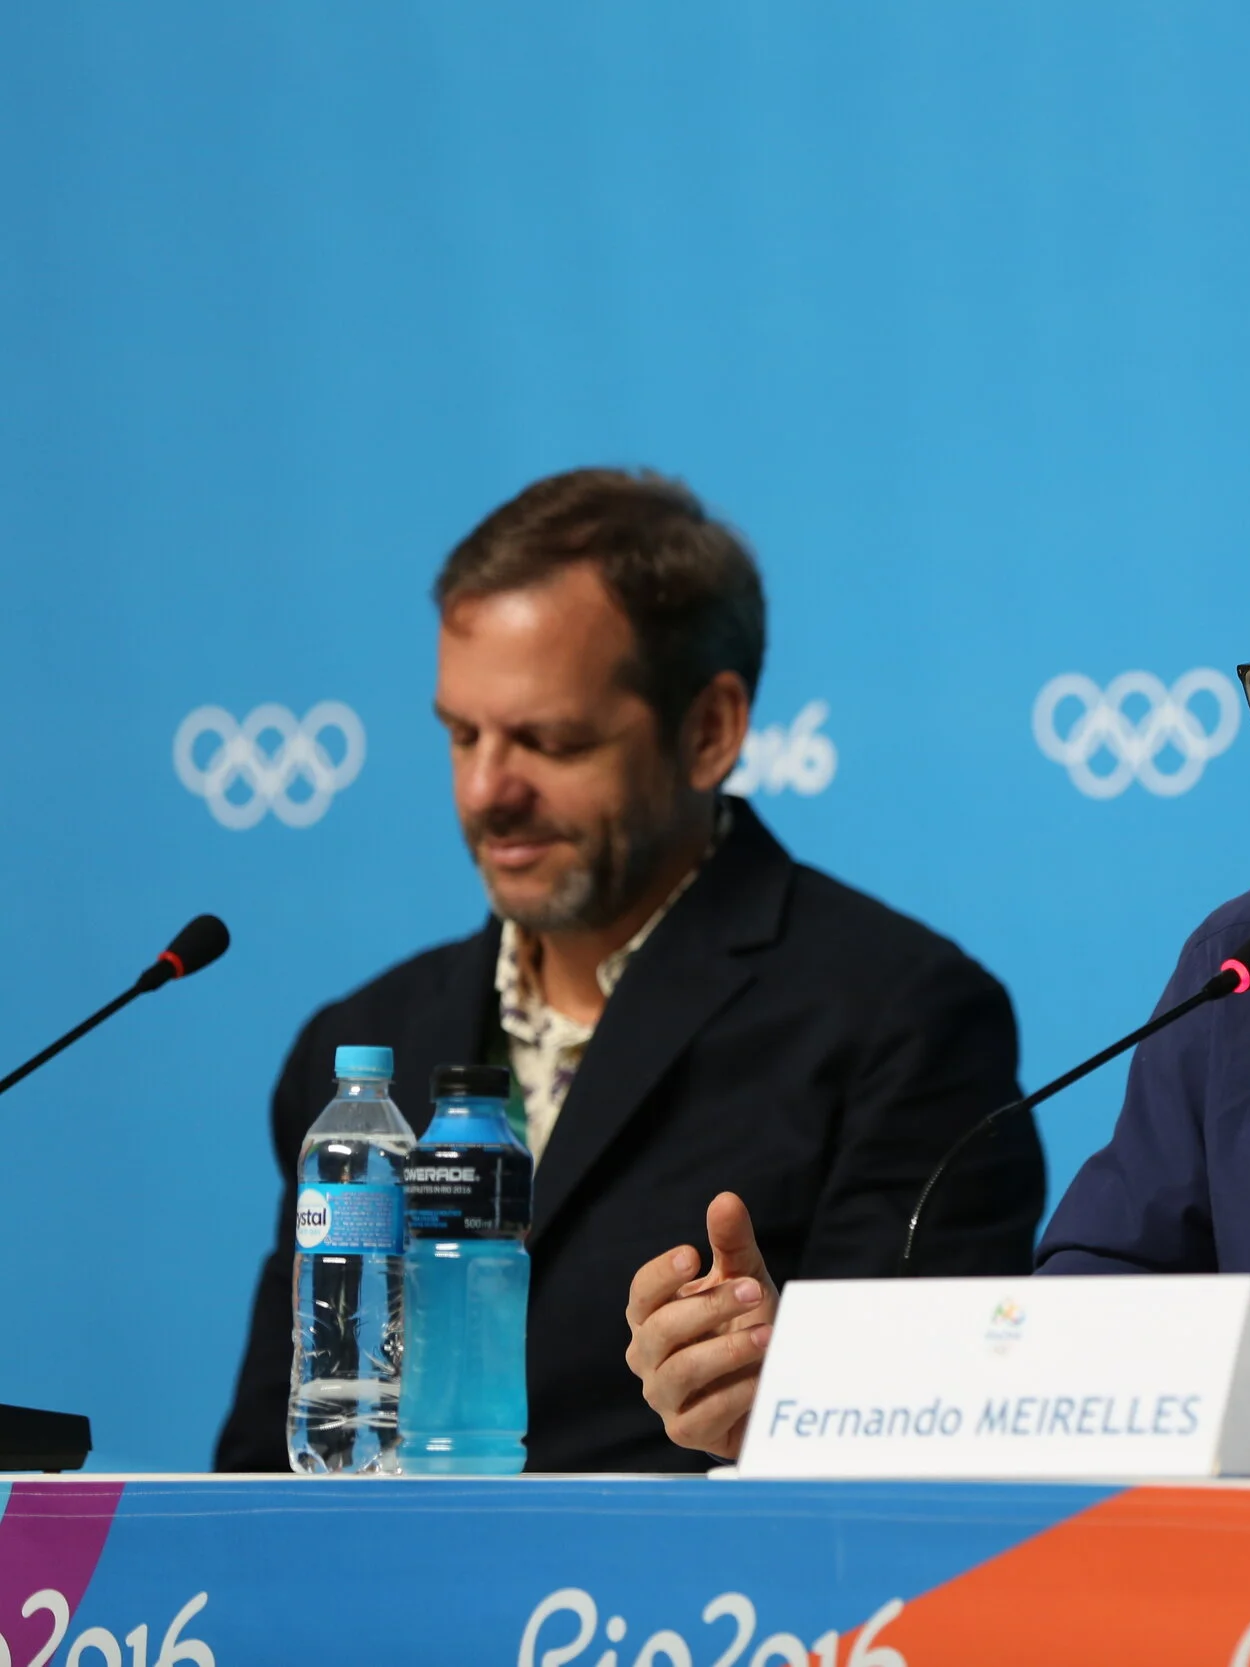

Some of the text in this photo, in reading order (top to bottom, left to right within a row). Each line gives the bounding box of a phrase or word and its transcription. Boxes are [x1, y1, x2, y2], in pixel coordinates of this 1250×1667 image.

[769, 1396, 1202, 1437] Fernando MEIRELLES
[0, 1588, 216, 1667] 2016
